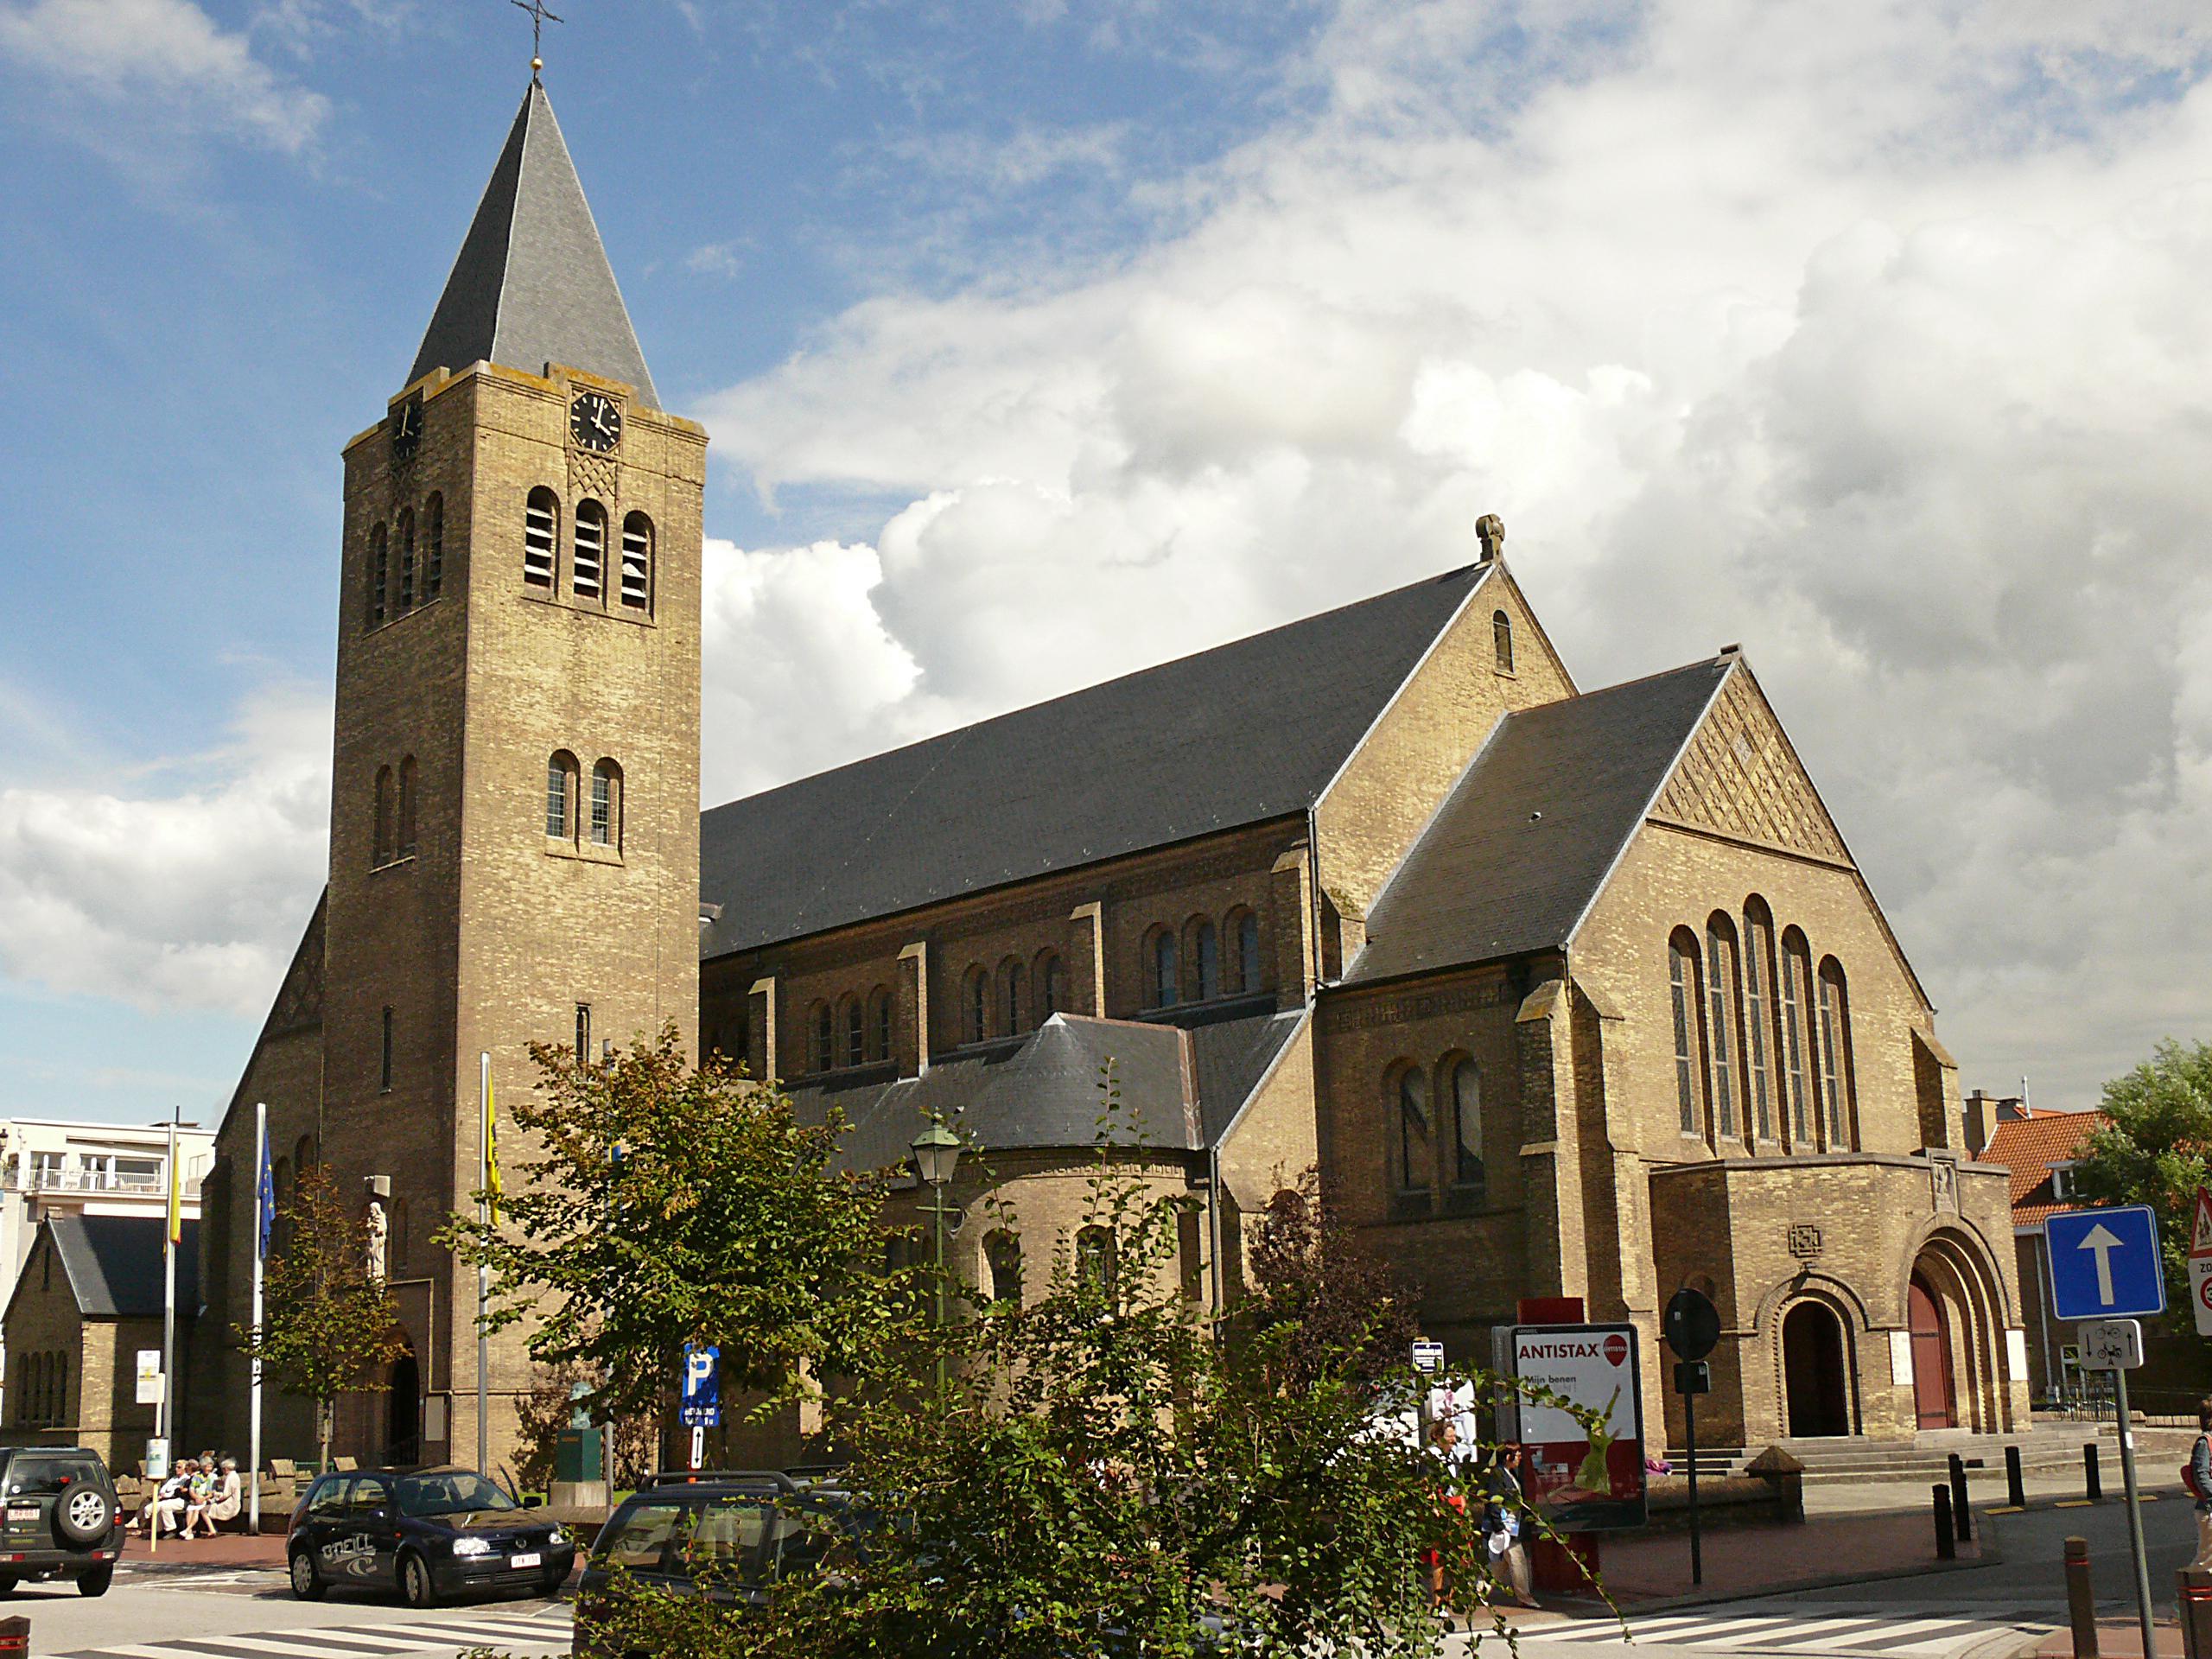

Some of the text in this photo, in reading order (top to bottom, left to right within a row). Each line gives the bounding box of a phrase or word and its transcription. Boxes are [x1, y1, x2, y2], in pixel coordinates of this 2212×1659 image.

[1518, 1343, 1600, 1359] ANTISTAX
[688, 1353, 714, 1396] P
[1548, 1374, 1577, 1383] benen
